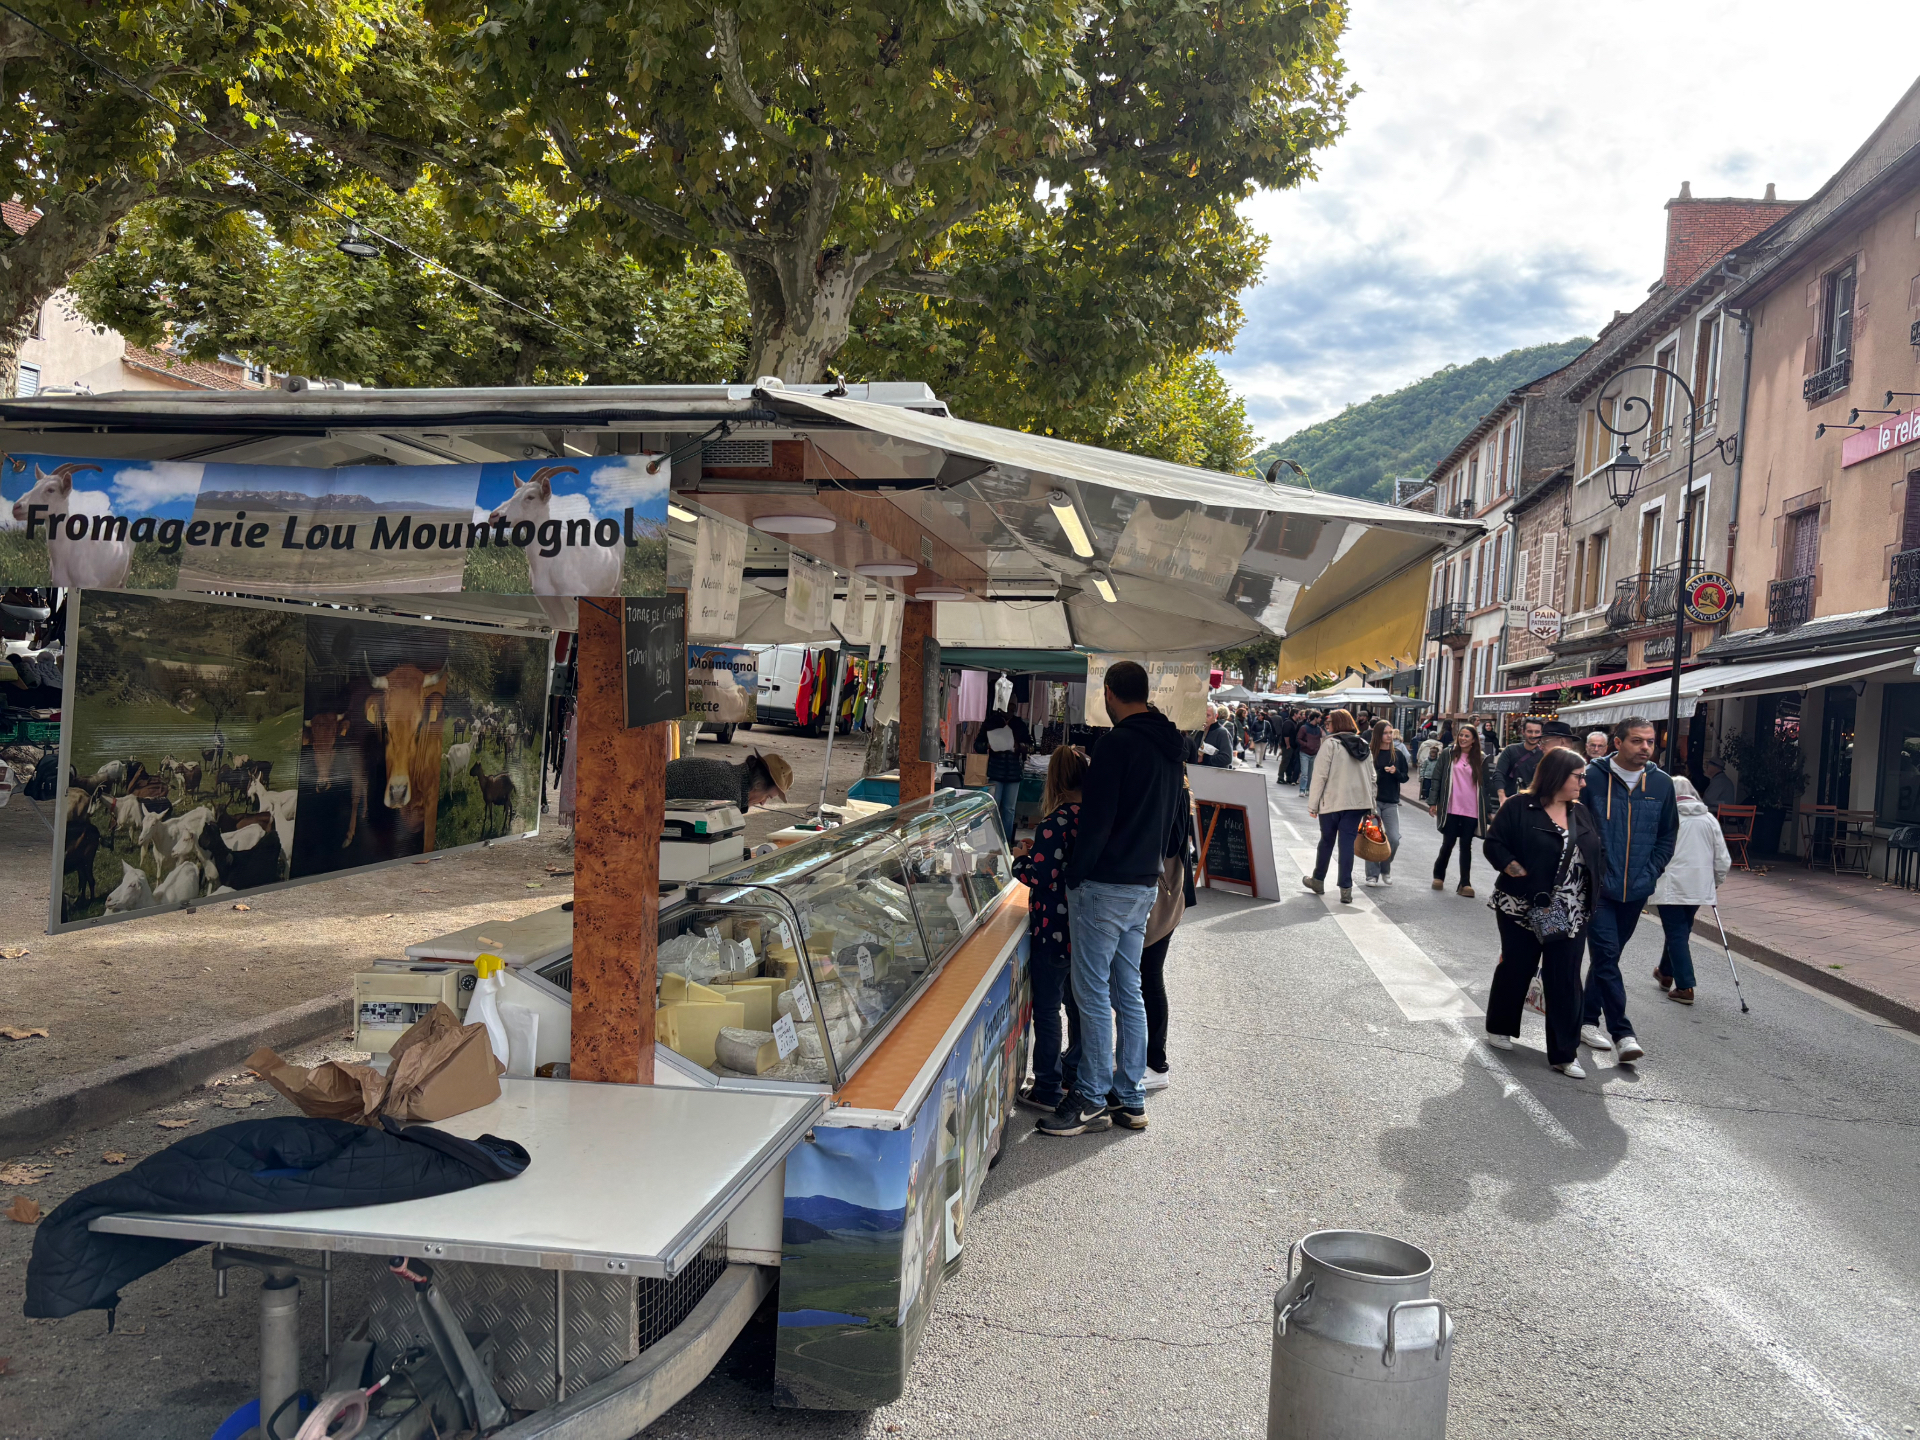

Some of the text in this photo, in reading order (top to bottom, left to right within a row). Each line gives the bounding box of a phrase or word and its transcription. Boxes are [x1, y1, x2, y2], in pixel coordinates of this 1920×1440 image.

[1878, 424, 1890, 452] le
[26, 504, 639, 558] Fromagerie Lou Mountognol
[1687, 575, 1733, 597] PAULANER
[1510, 604, 1529, 612] BIBAL
[1535, 611, 1556, 619] PAIN
[690, 656, 757, 674] Mountognol
